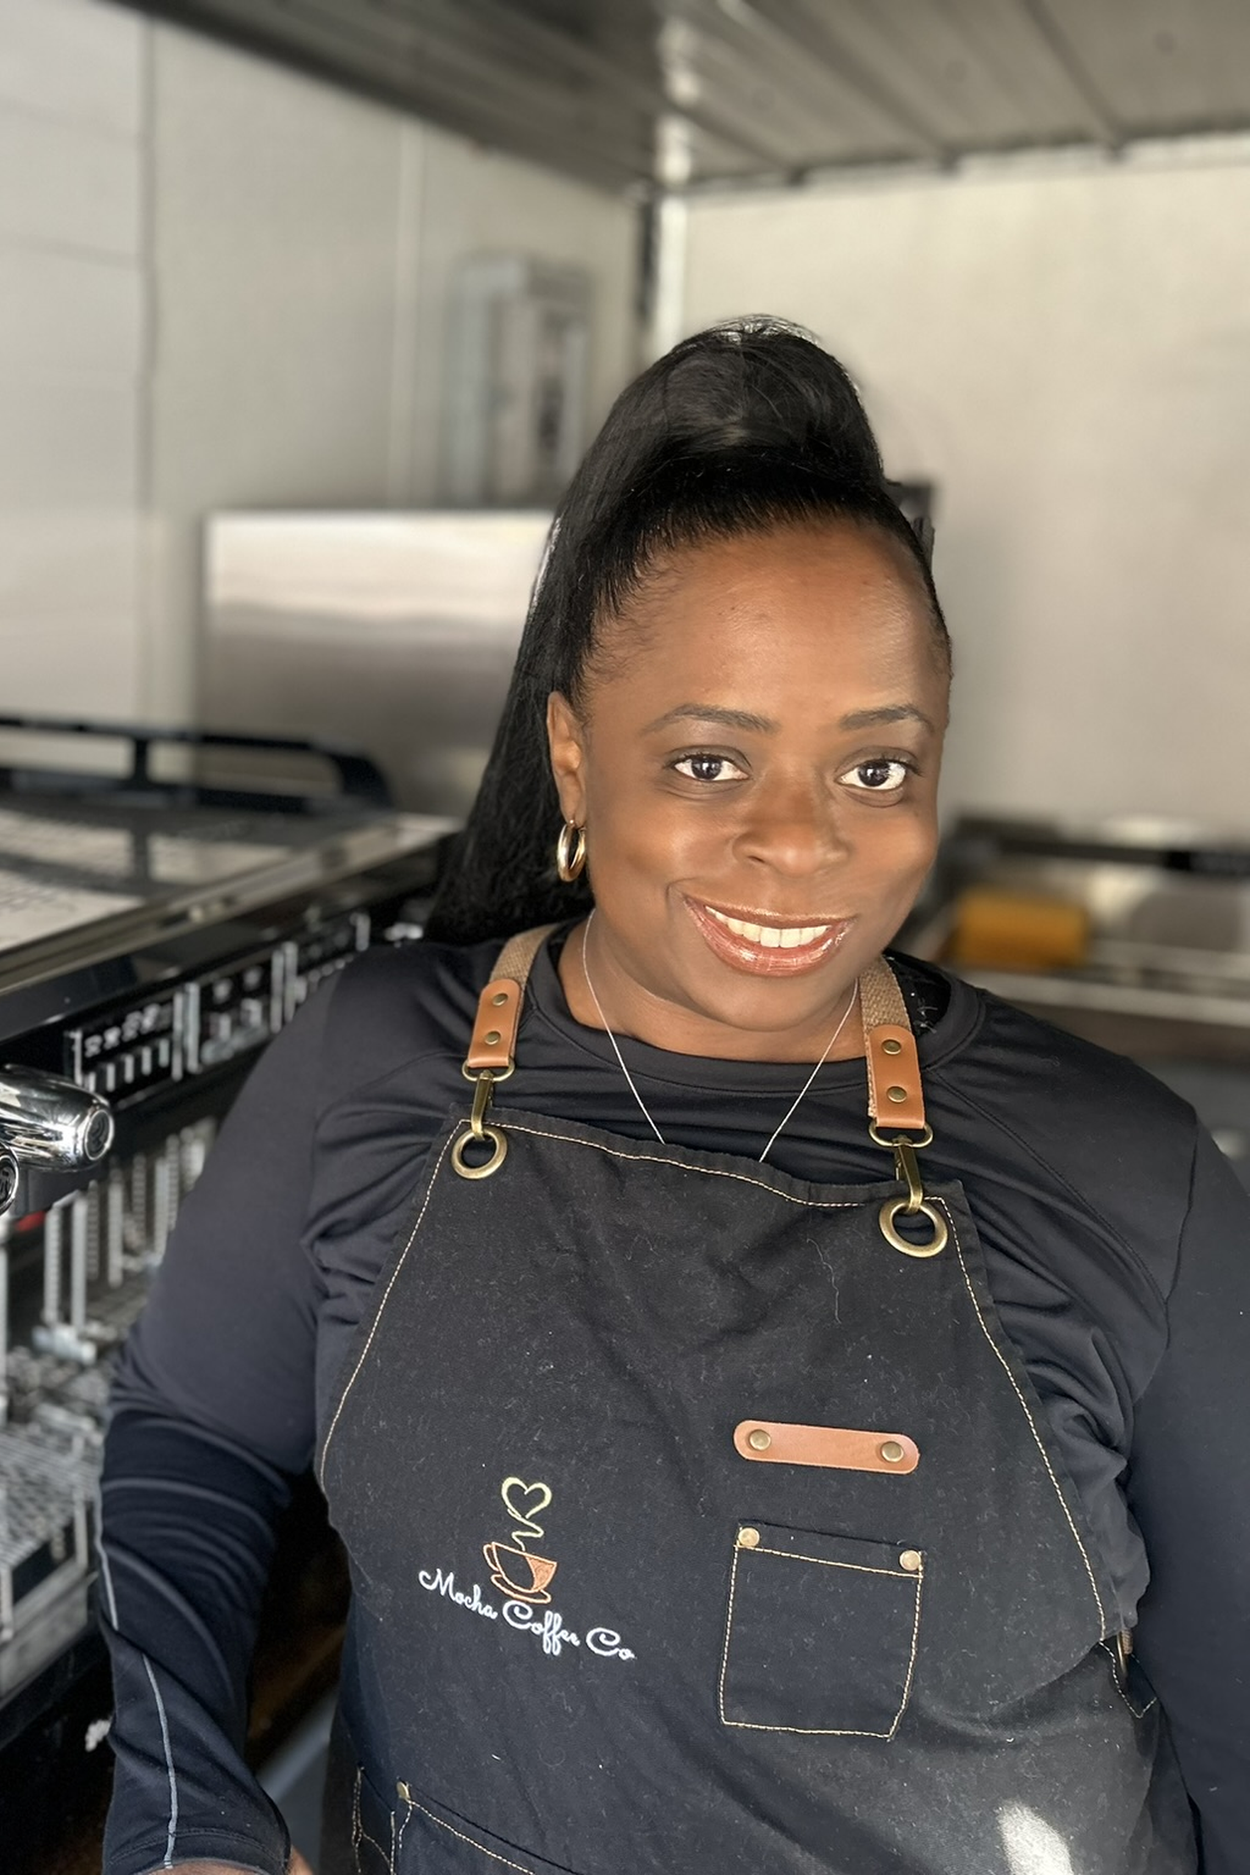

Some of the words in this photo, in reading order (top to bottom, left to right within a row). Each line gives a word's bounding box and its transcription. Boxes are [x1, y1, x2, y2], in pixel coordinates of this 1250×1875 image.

[418, 1568, 499, 1620] Mocha
[502, 1600, 581, 1656] Coffee
[585, 1627, 636, 1660] Co
